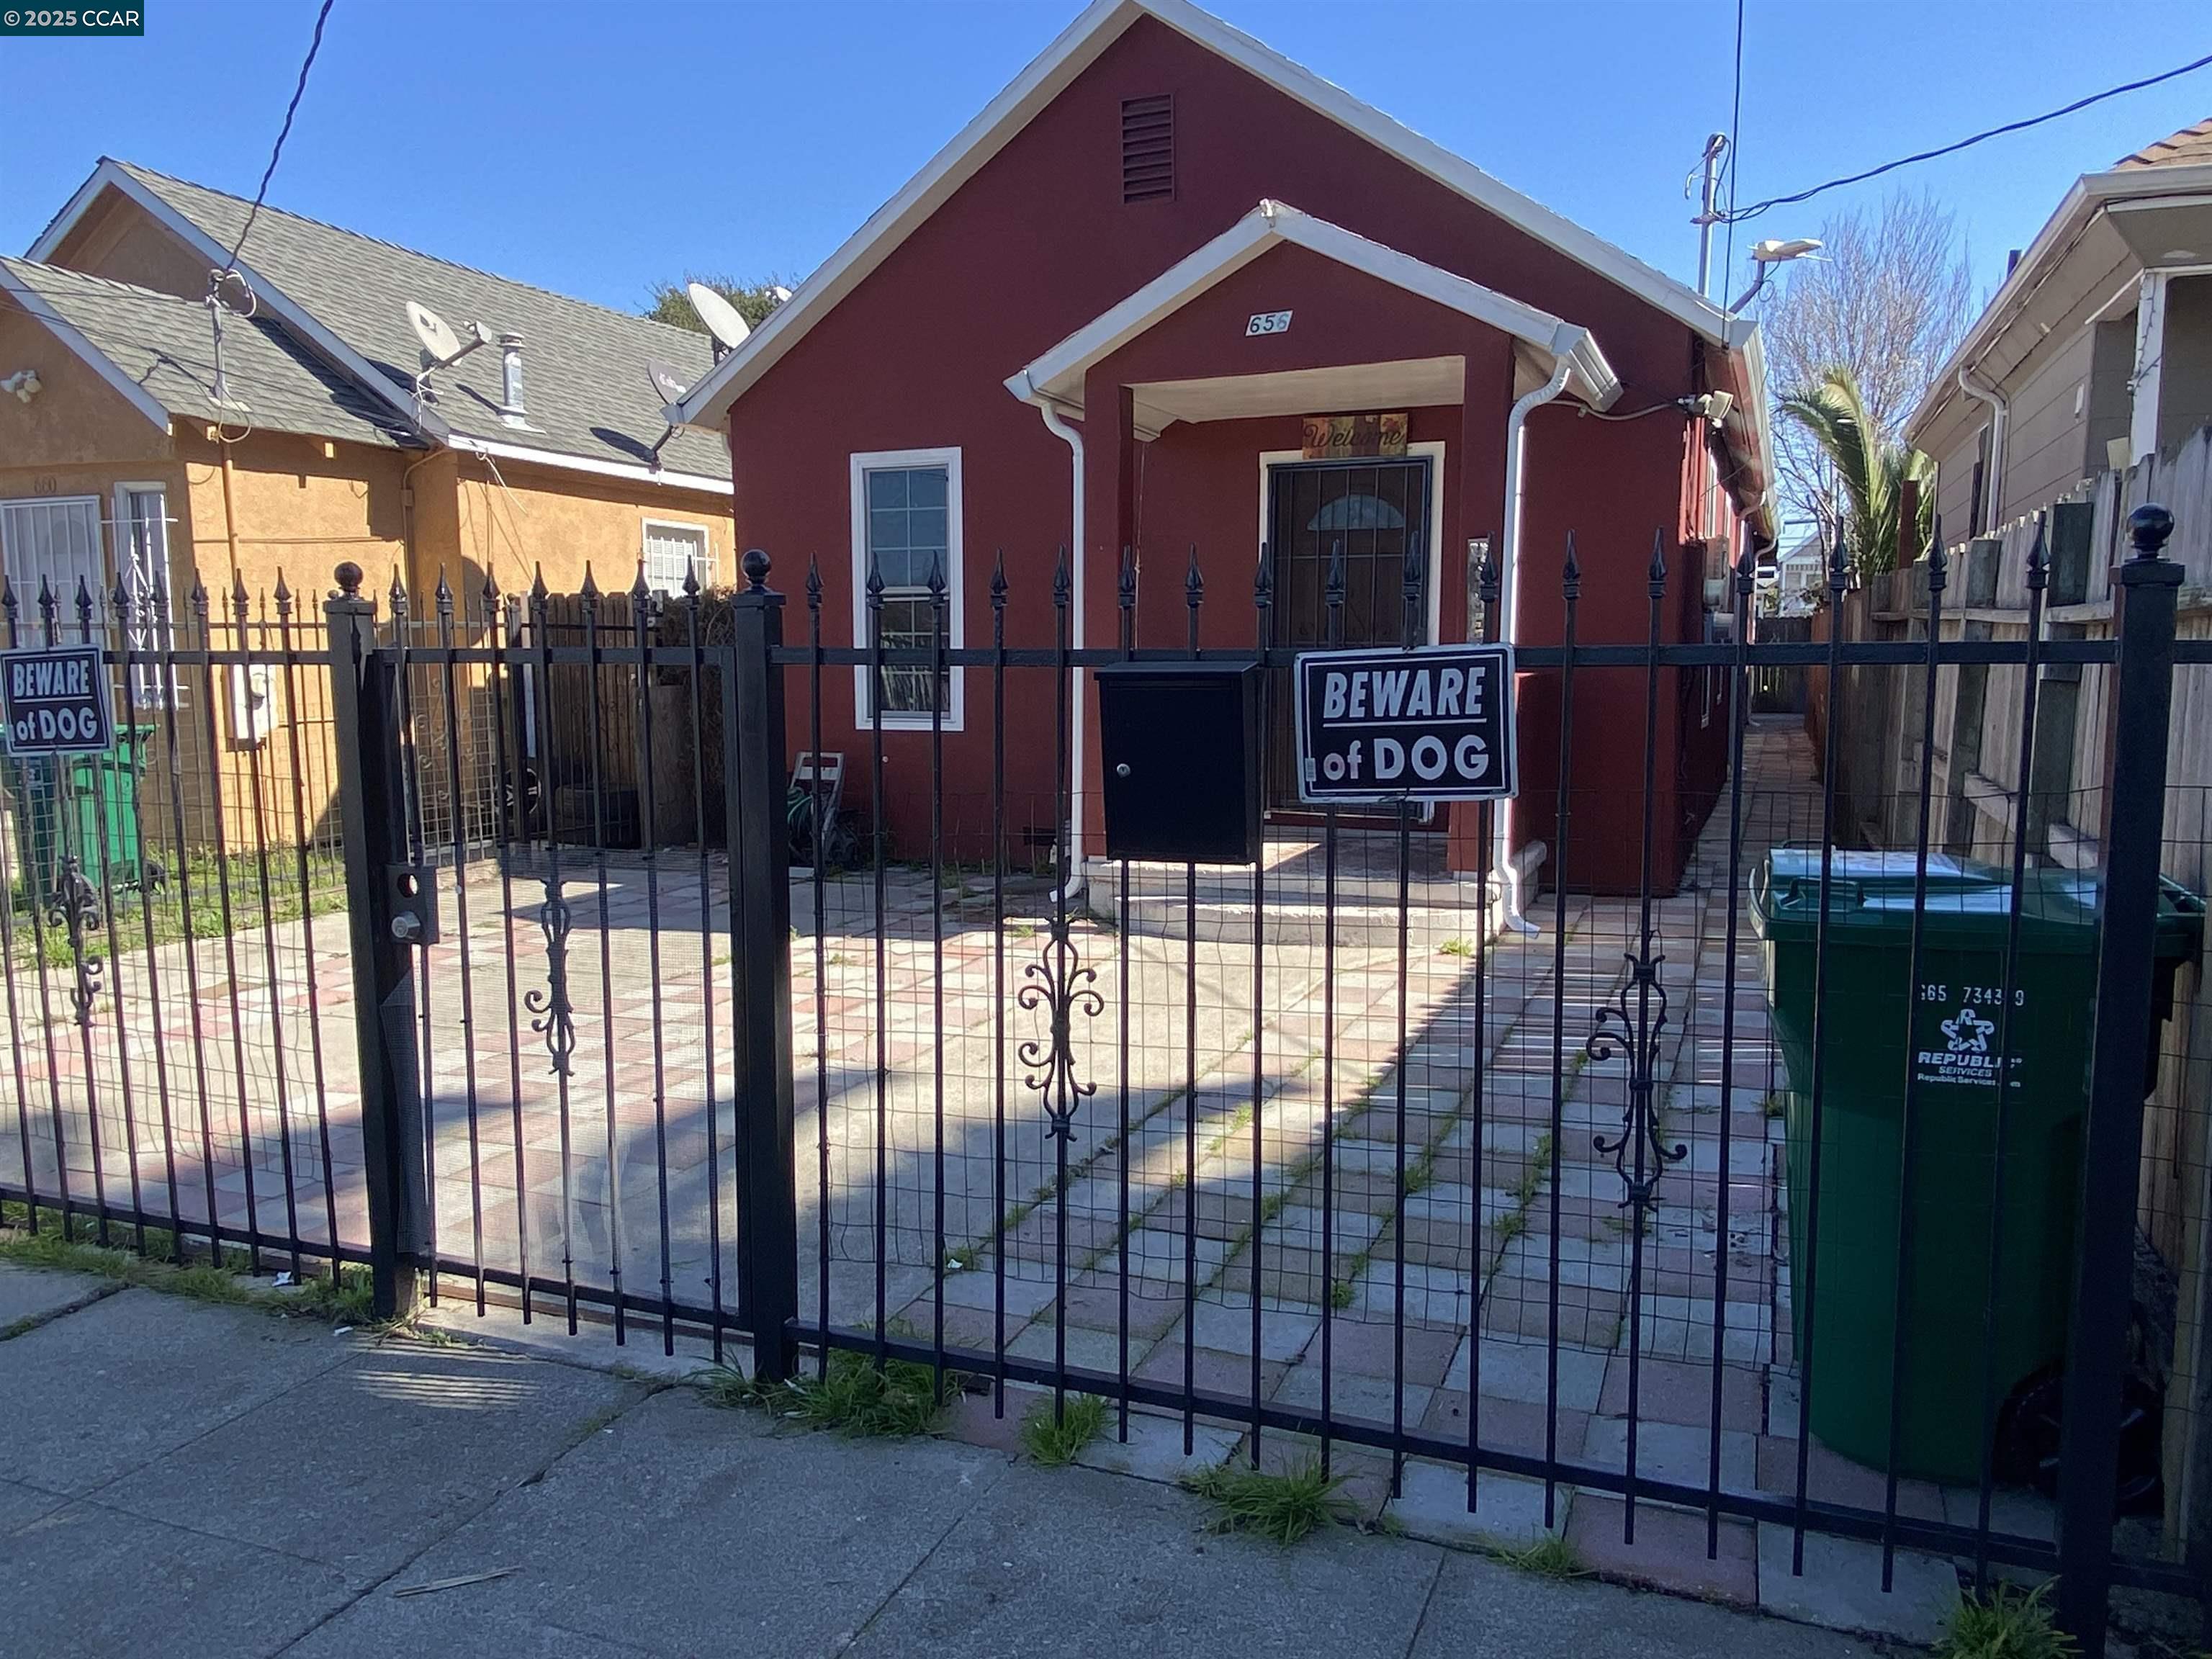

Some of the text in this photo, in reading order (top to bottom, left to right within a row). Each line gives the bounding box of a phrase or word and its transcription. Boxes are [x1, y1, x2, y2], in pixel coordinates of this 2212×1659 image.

[13, 660, 90, 697] BEWARE
[1323, 667, 1486, 719] BEWARE
[16, 707, 98, 741] of DOG
[1323, 734, 1489, 781] of DOG
[1962, 986, 2025, 1007] 73439
[1917, 1051, 2018, 1069] REPUBLI
[1938, 1066, 1992, 1077] SERVICES
